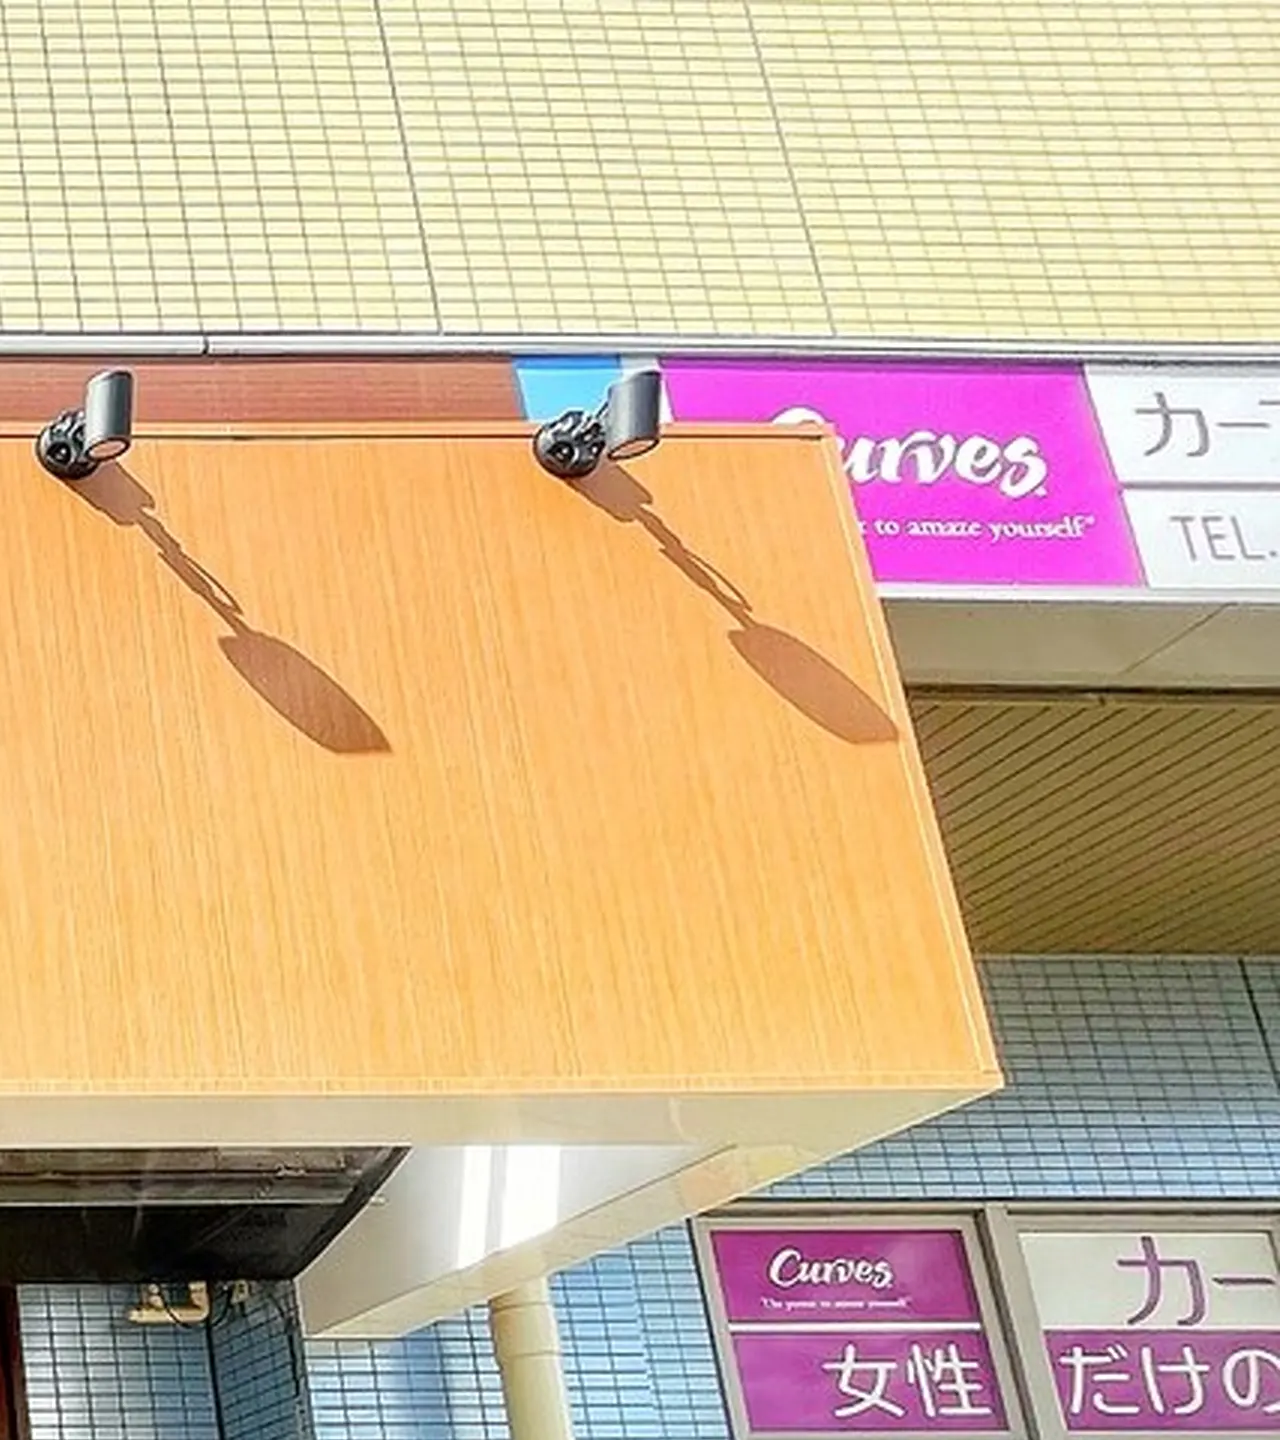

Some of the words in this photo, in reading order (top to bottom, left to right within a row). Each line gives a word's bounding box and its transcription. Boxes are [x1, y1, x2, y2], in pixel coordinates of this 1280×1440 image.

[771, 405, 1047, 497] urves
[875, 520, 900, 536] to
[904, 521, 982, 536] amaze
[769, 1249, 894, 1289] Curves
[822, 1344, 993, 1418] 女性
[1058, 1344, 1280, 1416] だけの
